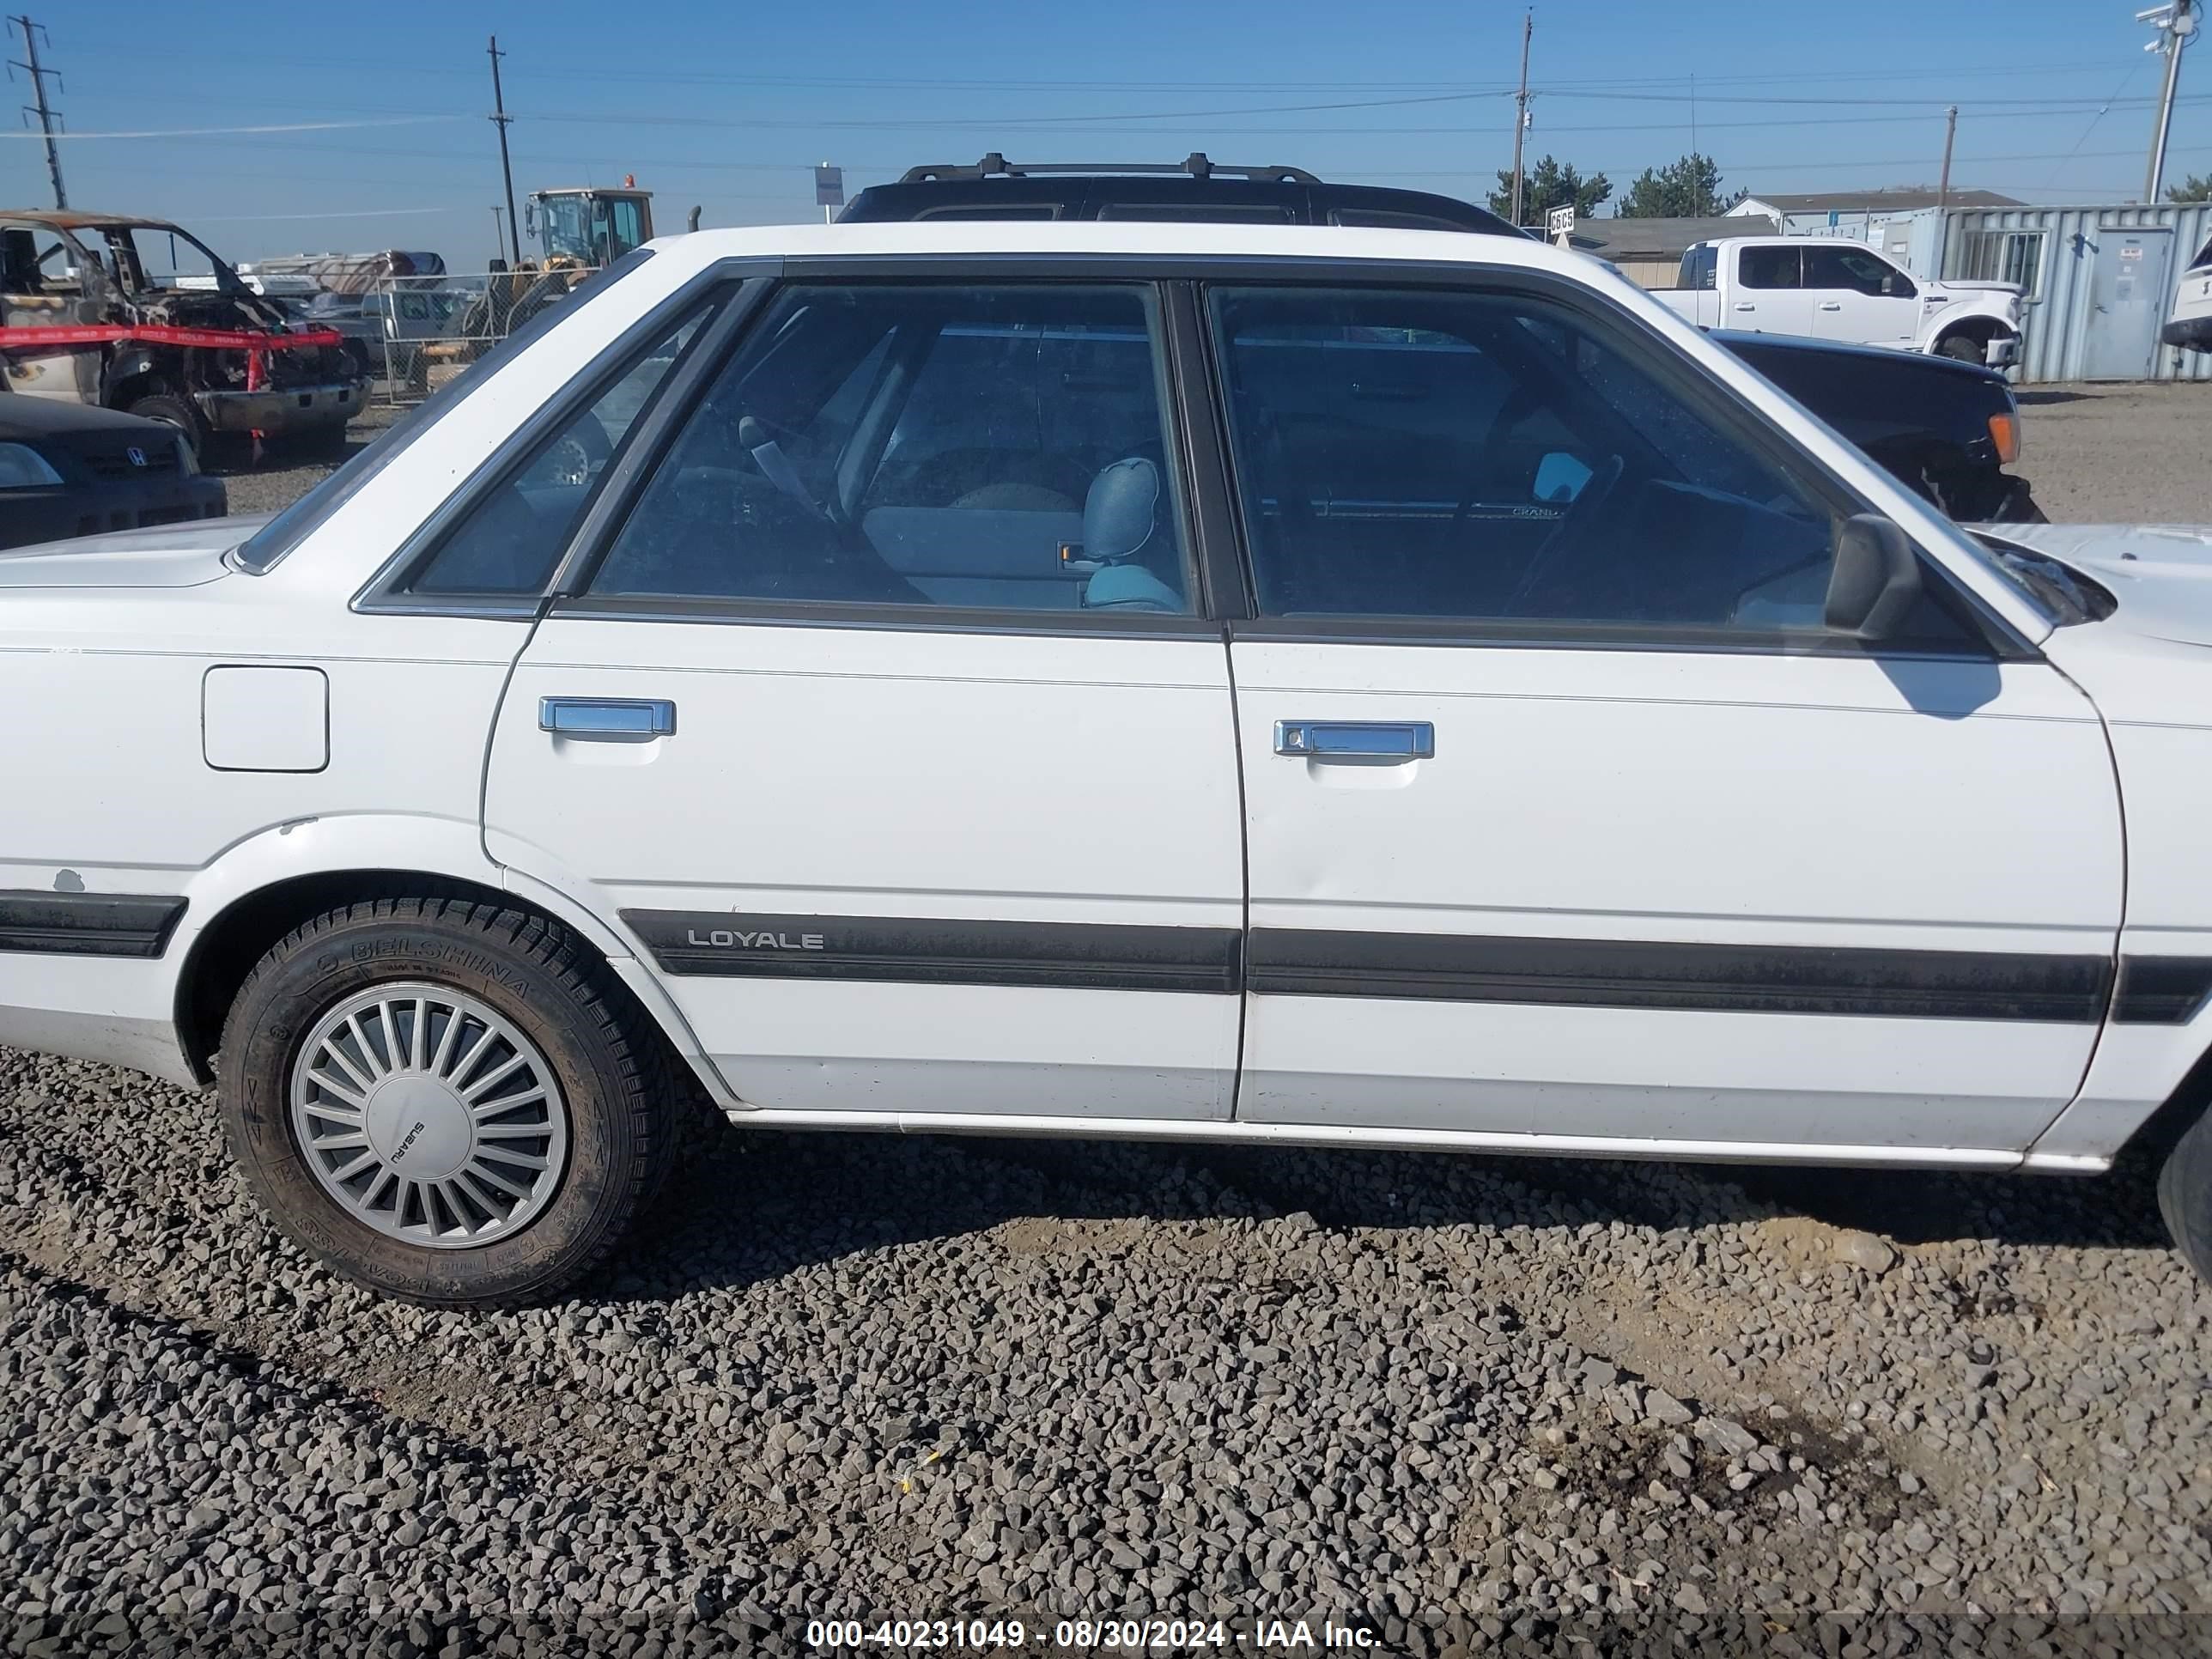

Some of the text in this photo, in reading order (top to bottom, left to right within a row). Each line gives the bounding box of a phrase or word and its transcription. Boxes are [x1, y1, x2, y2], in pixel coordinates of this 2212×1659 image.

[1552, 211, 1573, 231] C6 C5
[688, 930, 823, 949] LOYALE
[351, 935, 531, 999] BELSHINA
[391, 1121, 425, 1164] SUBARU
